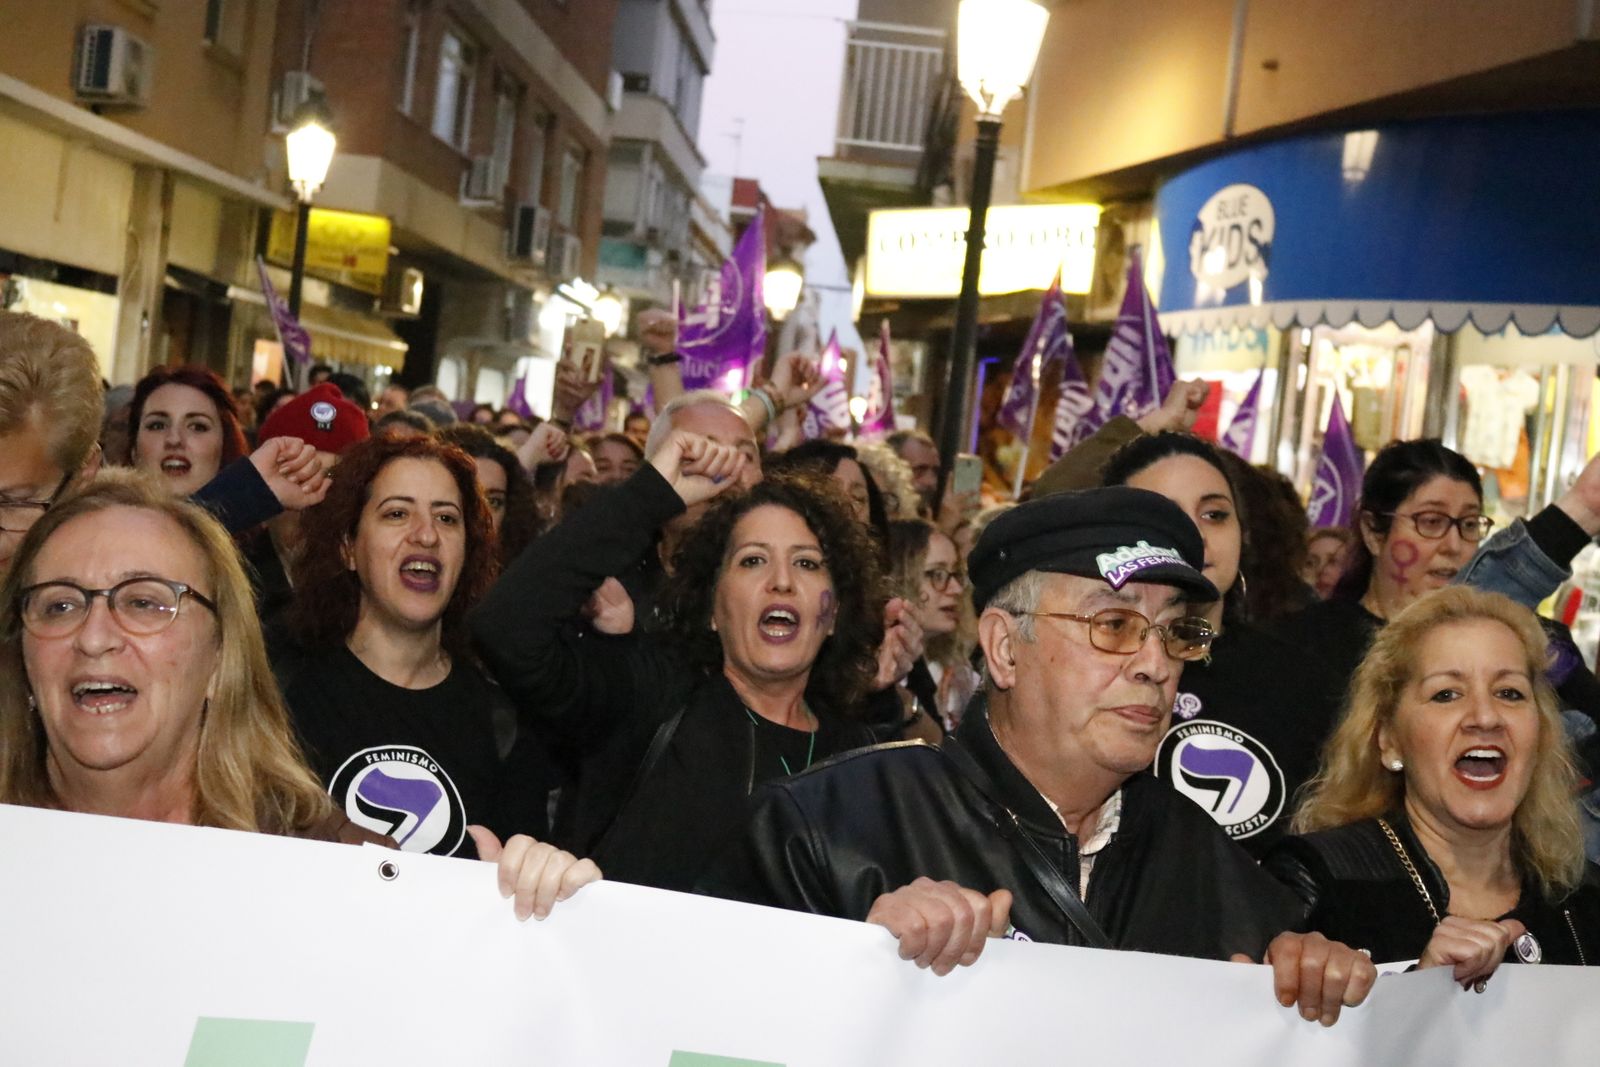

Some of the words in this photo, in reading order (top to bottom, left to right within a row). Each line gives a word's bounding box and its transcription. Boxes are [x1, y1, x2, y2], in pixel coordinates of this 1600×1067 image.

[1217, 195, 1249, 220] BLUE
[877, 227, 1014, 254] COMPO
[1200, 218, 1263, 270] KIDS
[1107, 560, 1138, 586] LAS
[1175, 725, 1245, 744] FEMINISMO
[364, 750, 440, 774] FEMINISMO
